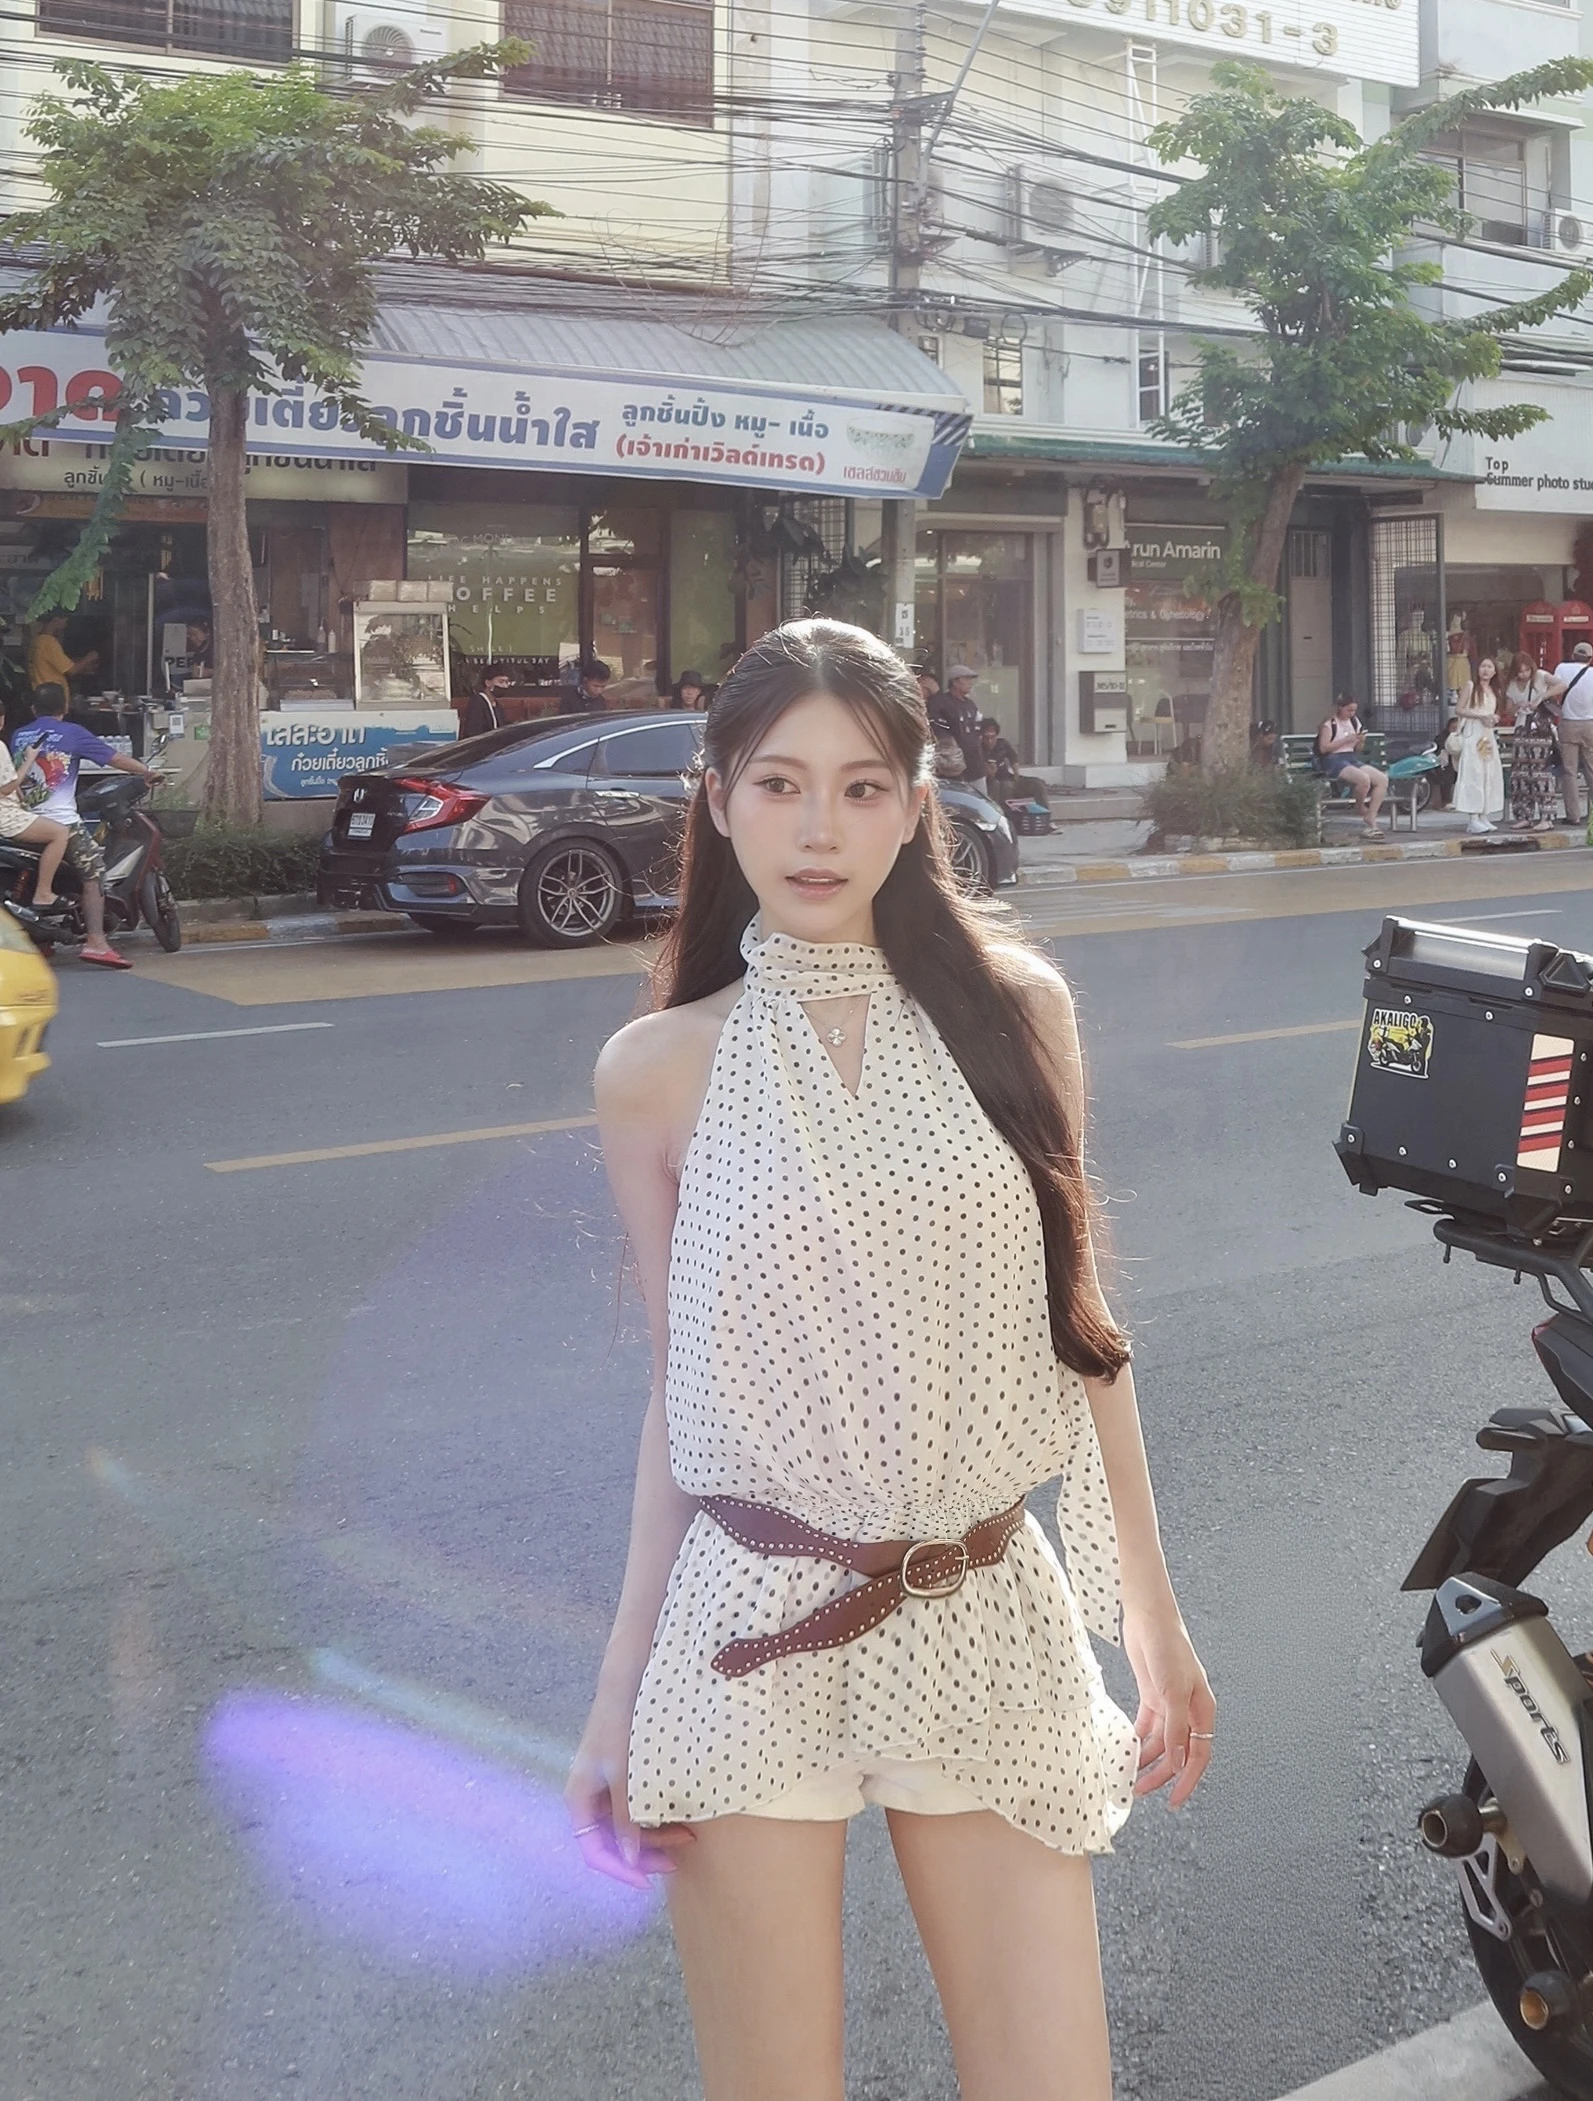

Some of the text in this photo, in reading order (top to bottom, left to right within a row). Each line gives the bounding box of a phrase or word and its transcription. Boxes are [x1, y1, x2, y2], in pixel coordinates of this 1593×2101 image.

[1067, 0, 1339, 56] 11031-3
[622, 395, 726, 428] ลูกชิ้นปิ้ง
[789, 409, 829, 439] เนื้อ
[615, 433, 826, 476] (เจ้าเก่าเวิลด์เทรด)
[1485, 456, 1509, 474] Top
[1485, 472, 1534, 487] Summer
[1537, 473, 1570, 492] photo
[1162, 541, 1221, 559] Amarin
[482, 576, 562, 586] HAPPENS
[456, 586, 557, 602] OFFEE
[448, 604, 546, 614] HELPS
[1373, 1010, 1417, 1029] AKALIGO
[1490, 1648, 1571, 1765] Sports
